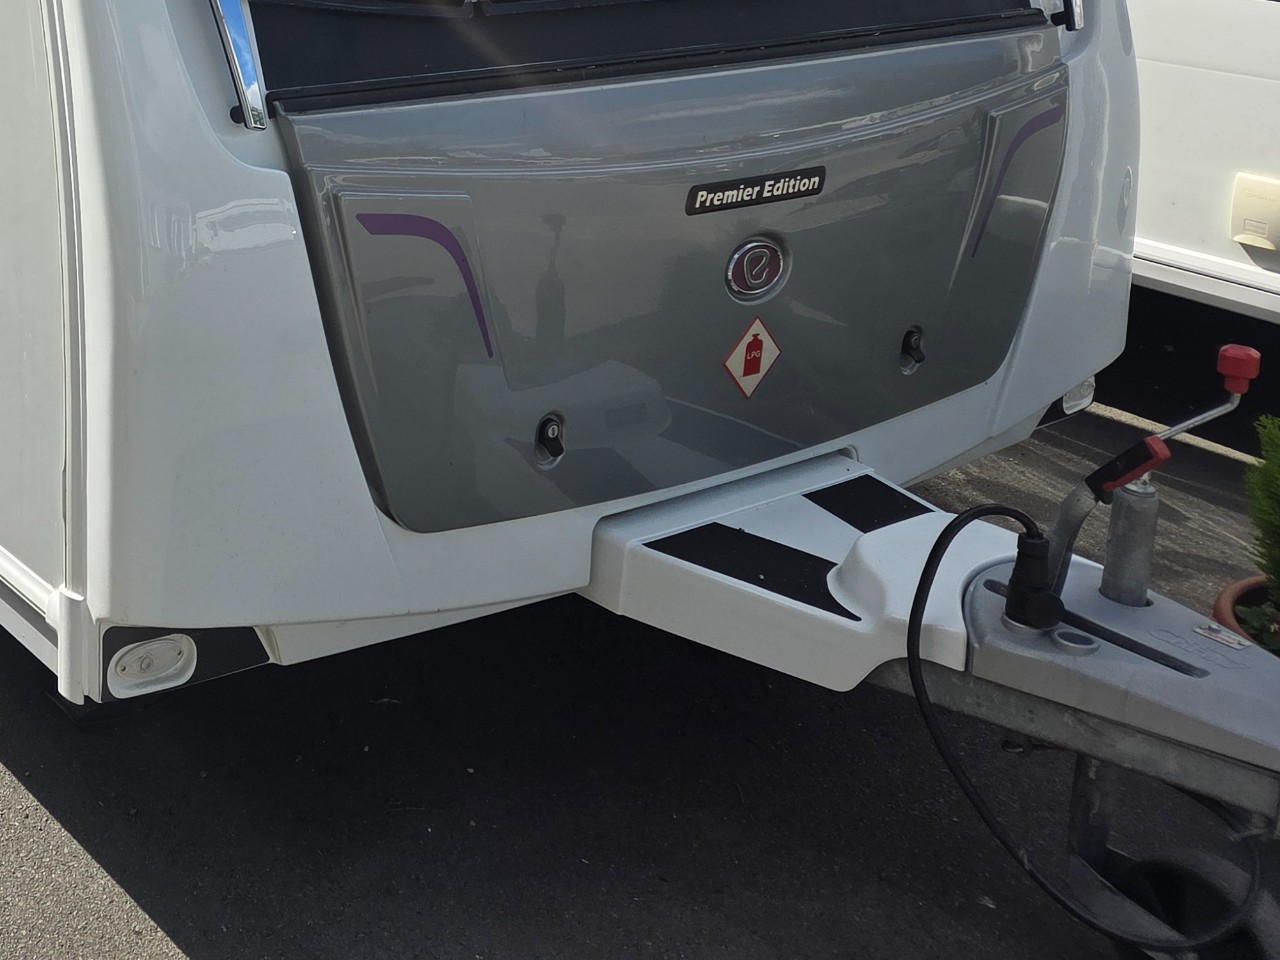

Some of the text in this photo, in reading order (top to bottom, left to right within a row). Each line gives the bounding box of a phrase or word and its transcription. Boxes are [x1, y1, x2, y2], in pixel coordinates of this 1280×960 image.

[695, 174, 820, 208] Premier Edition
[747, 350, 761, 360] LPG
